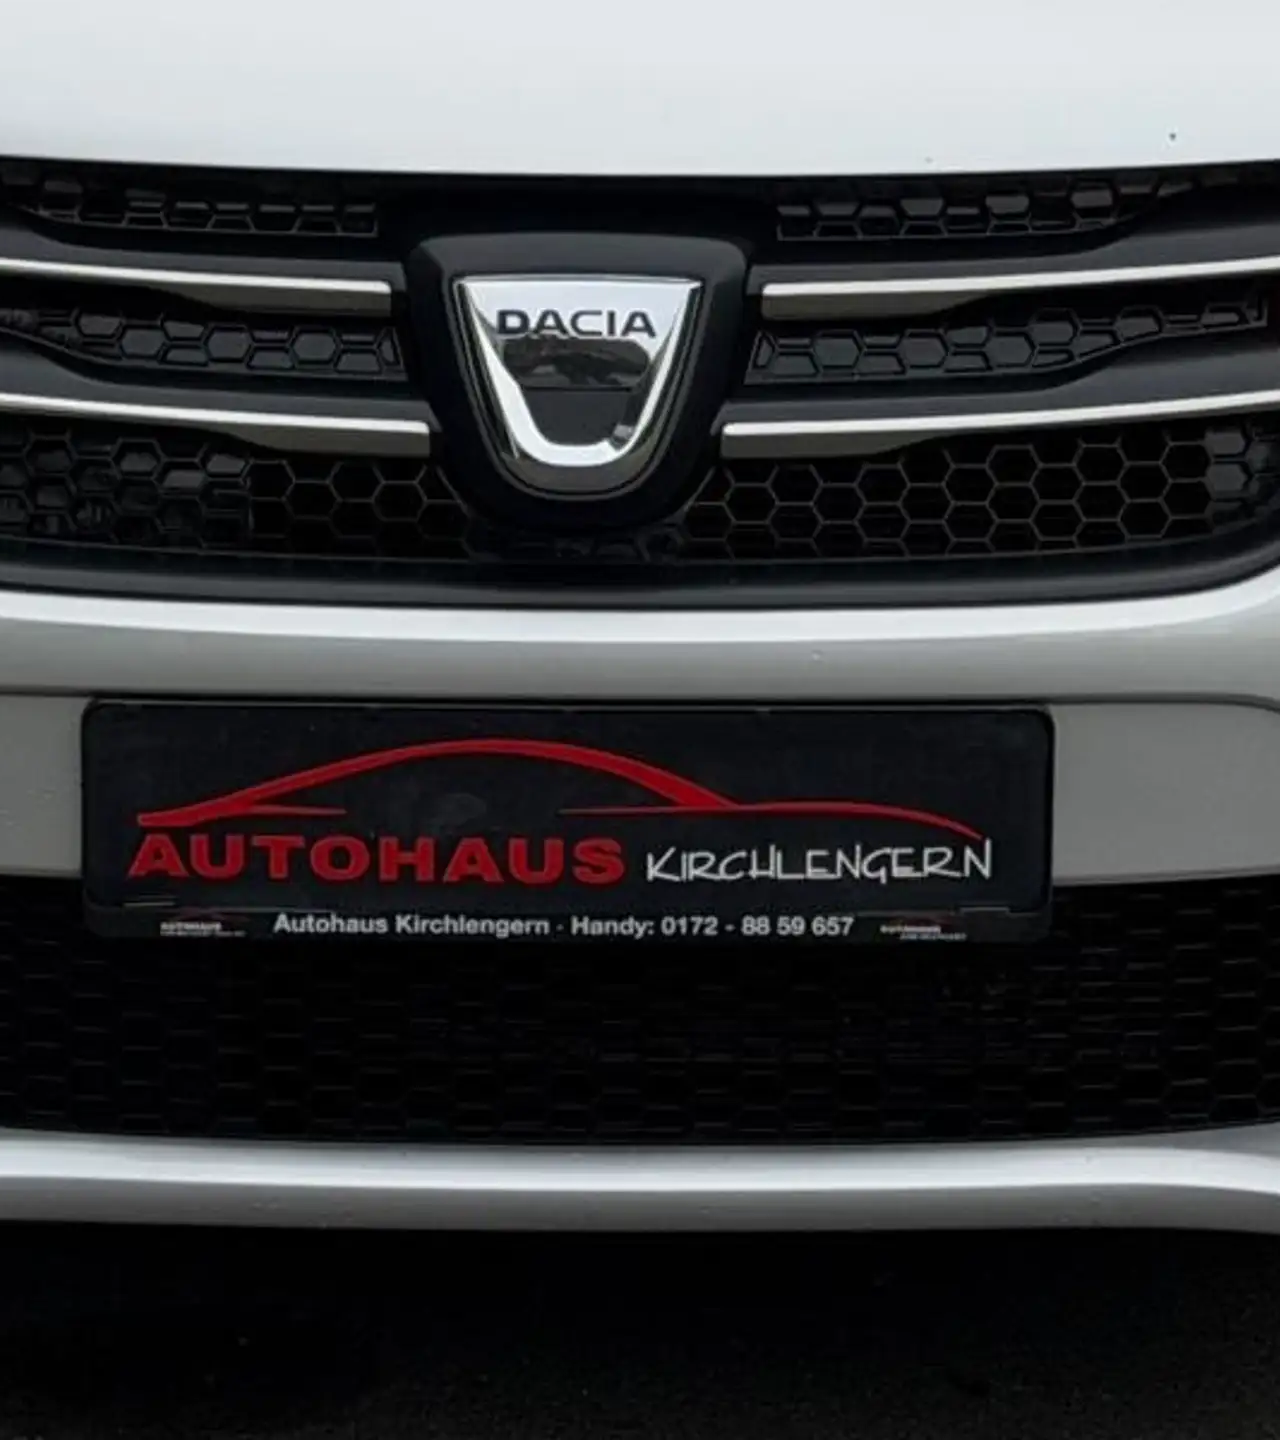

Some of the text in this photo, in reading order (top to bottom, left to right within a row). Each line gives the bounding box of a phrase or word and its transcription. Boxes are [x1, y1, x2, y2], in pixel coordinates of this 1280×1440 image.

[497, 309, 656, 337] DACIA
[128, 834, 991, 884] AUTOHAUS KIRCHLENGERN
[274, 913, 388, 934] Autohaus
[396, 914, 549, 938] Kirchlengern
[571, 915, 654, 939] Handy:
[661, 916, 718, 936] 0172
[741, 916, 770, 936] 88
[777, 916, 805, 936] 59
[811, 916, 854, 936] 657
